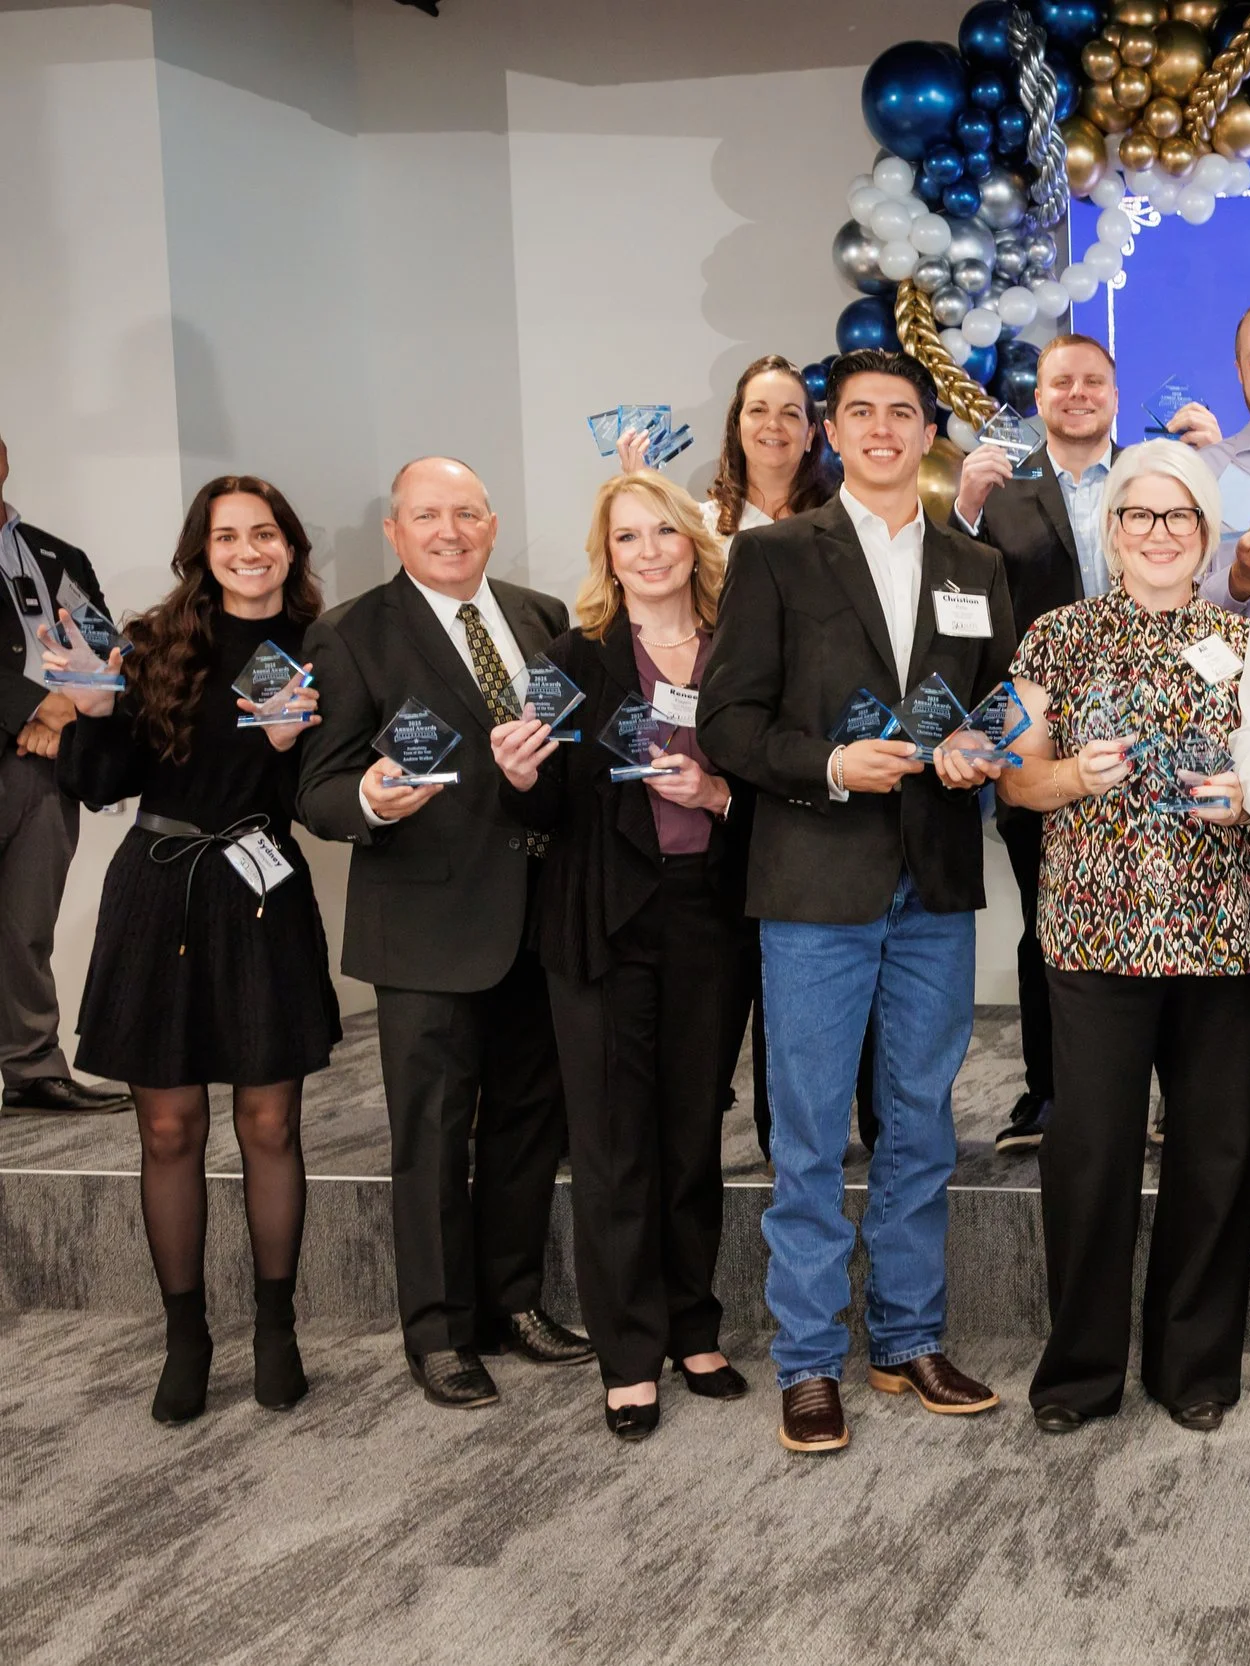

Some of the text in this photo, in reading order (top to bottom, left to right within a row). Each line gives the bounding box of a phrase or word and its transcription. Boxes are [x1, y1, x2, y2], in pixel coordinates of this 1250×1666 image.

[942, 594, 980, 605] Christian
[669, 688, 698, 700] Renee
[257, 838, 282, 867] Sydney
